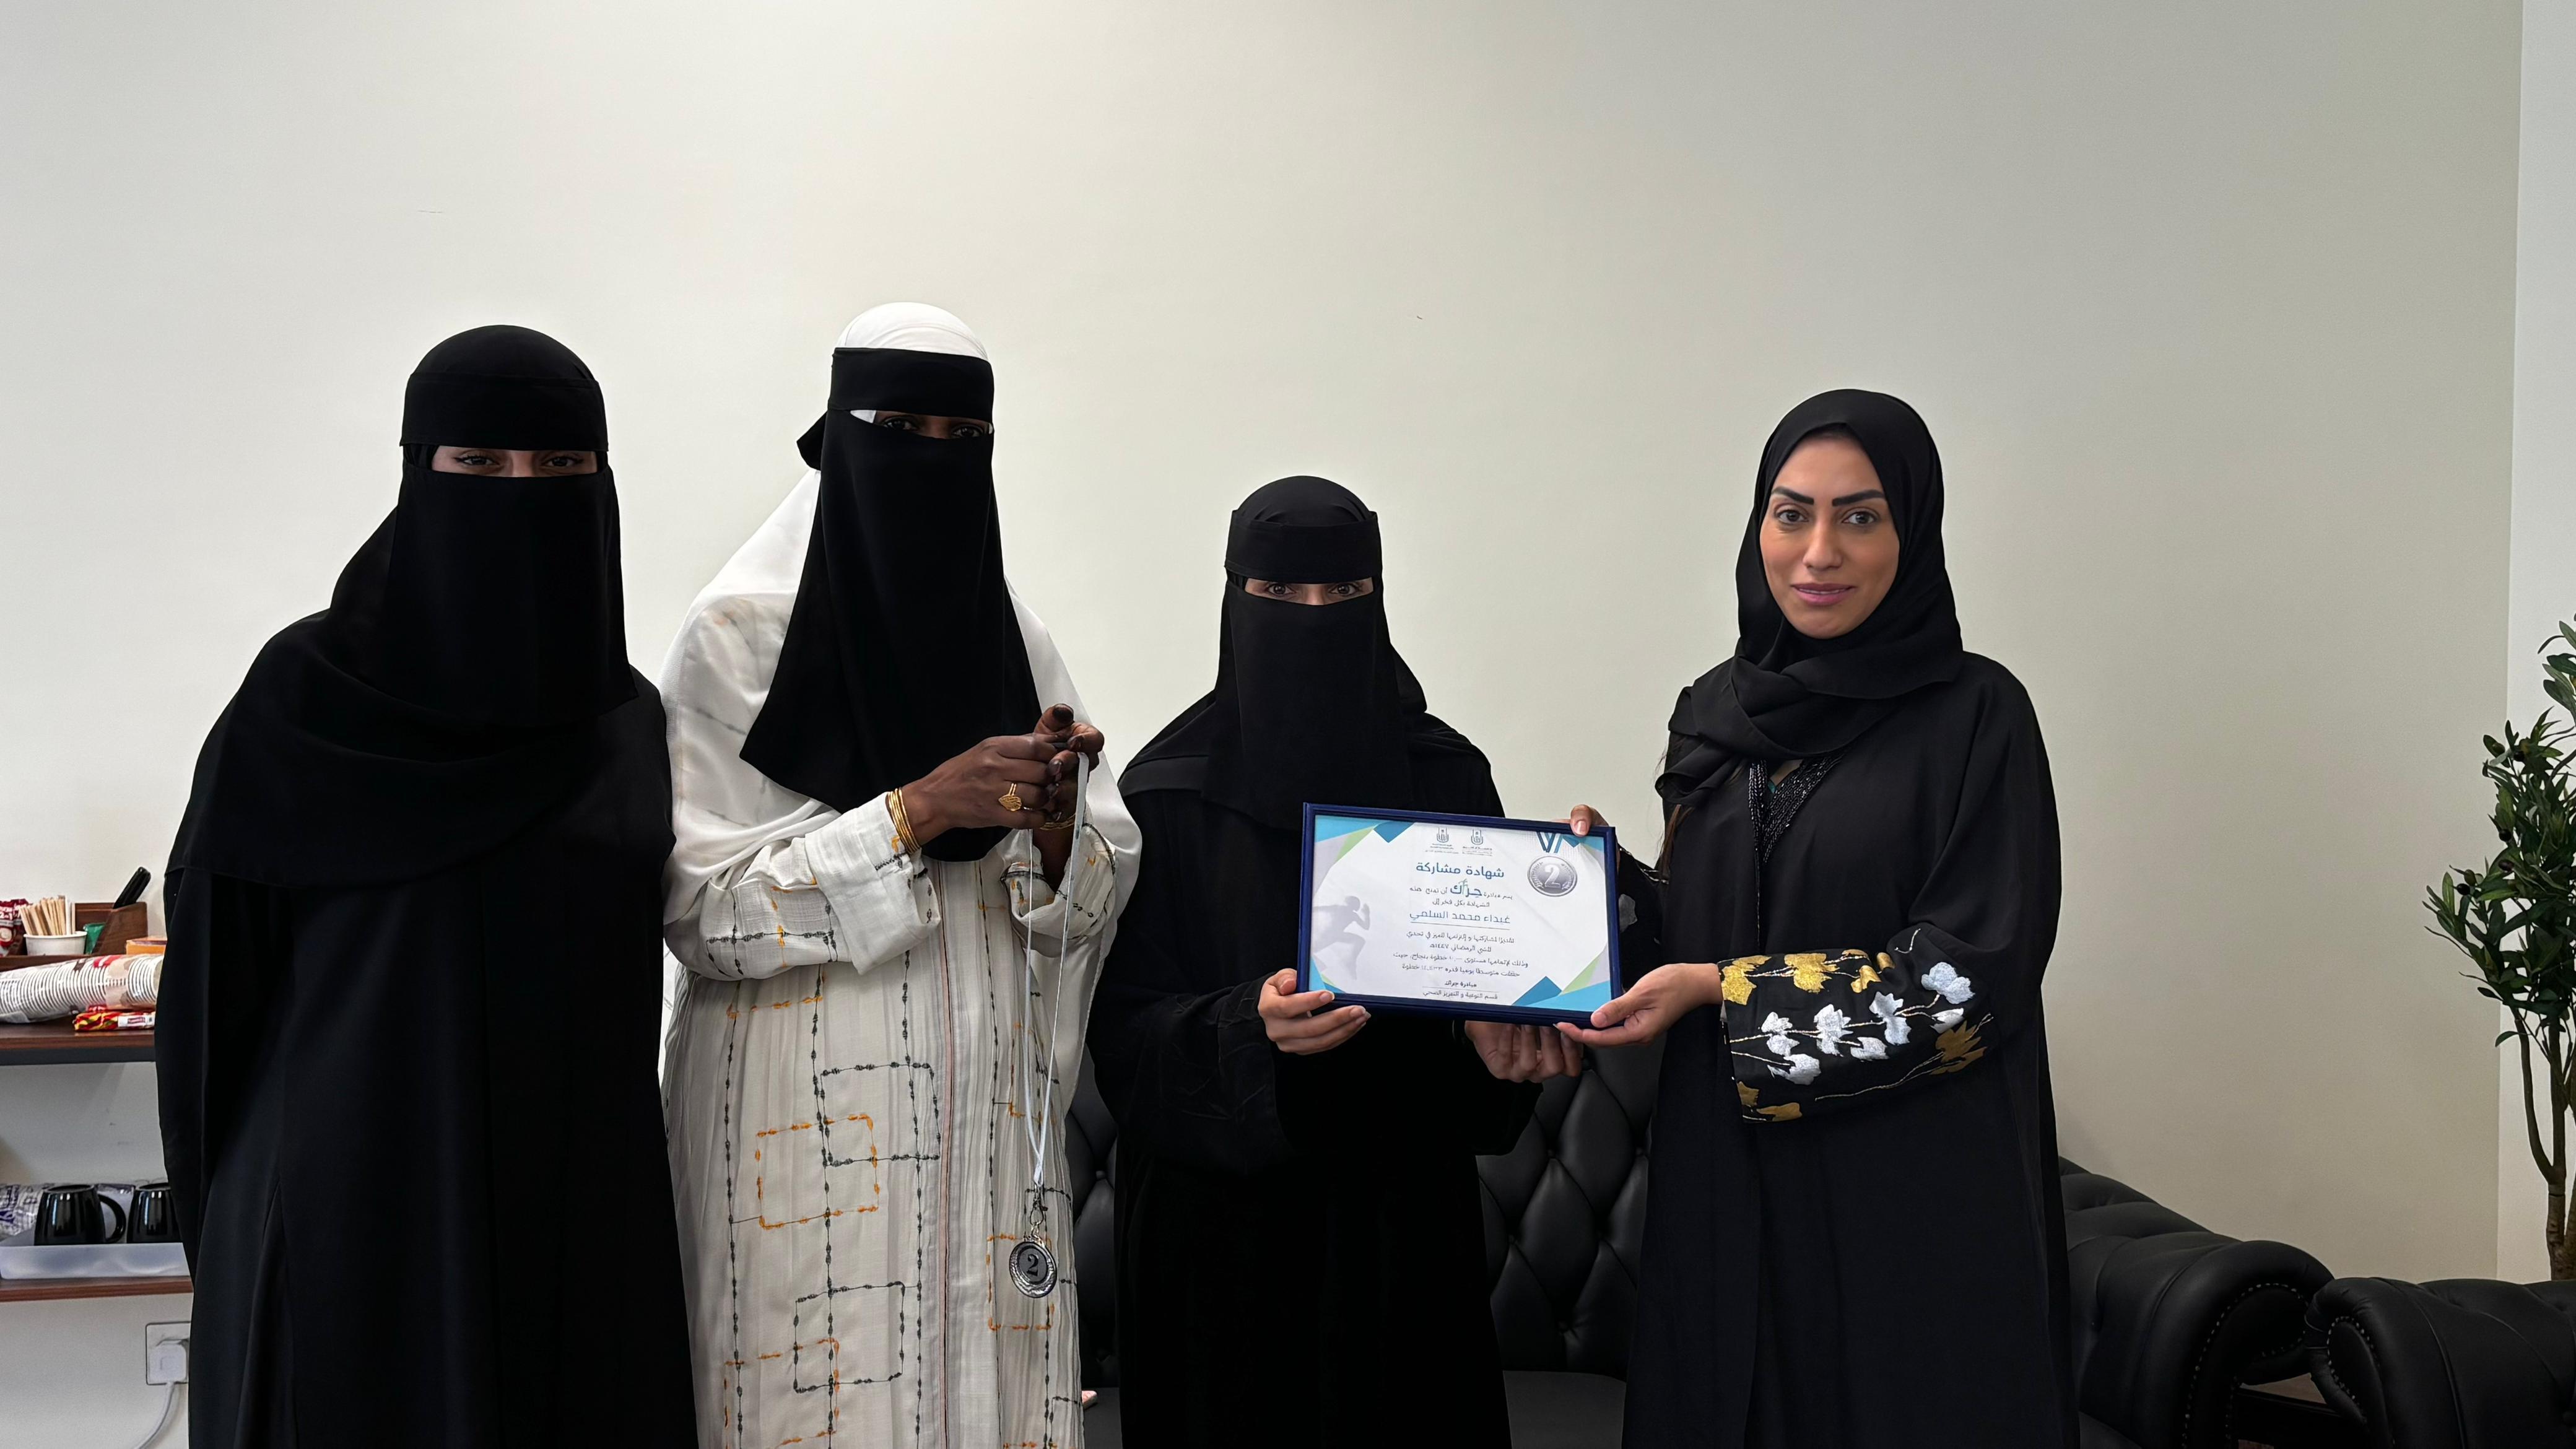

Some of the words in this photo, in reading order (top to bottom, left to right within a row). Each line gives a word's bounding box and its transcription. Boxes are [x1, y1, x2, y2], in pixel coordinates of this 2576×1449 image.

[1416, 862, 1461, 874] مشاركة
[1466, 865, 1504, 879] شهادة
[1544, 864, 1560, 888] 2
[1409, 910, 1448, 921] السلمي
[1452, 913, 1481, 921] محمد
[1026, 1253, 1039, 1277] 2
